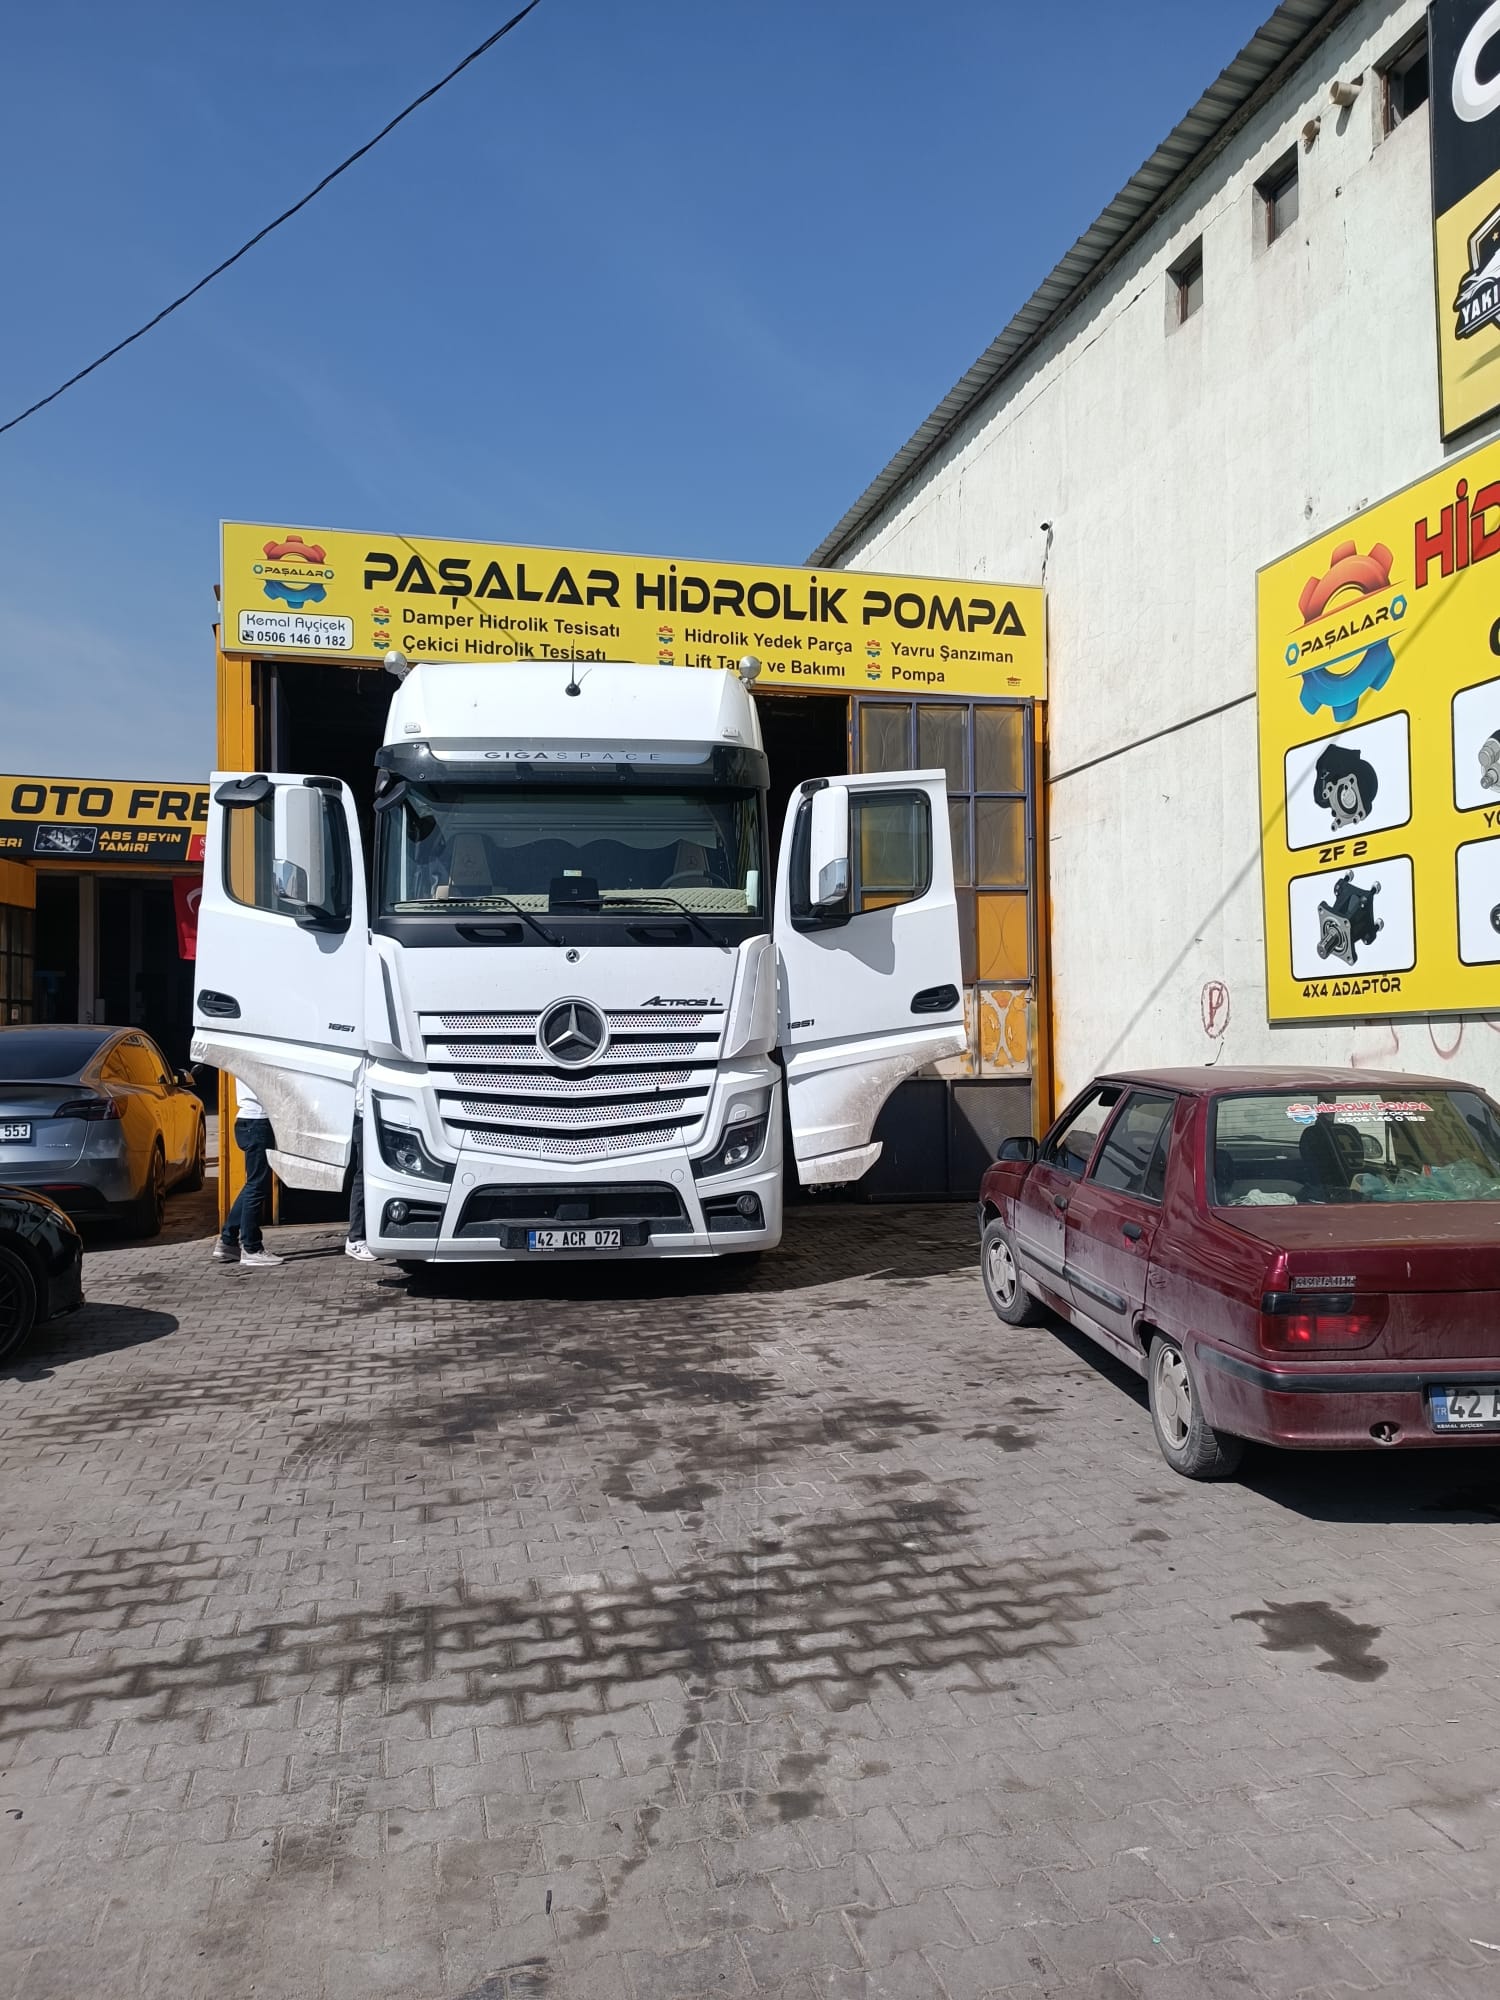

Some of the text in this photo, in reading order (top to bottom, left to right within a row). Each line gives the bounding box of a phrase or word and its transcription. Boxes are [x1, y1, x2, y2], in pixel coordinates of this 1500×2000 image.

[264, 566, 324, 577] PAŞALAR
[364, 551, 1027, 637] PAŞALAR HİDROLİK POMPA
[246, 613, 346, 634] Kemal Ayçiçek
[402, 608, 621, 638] Damper Hidrolik Tesisatı
[1300, 606, 1389, 657] PAŞALAR
[257, 631, 346, 647] 0506 146 0 182
[402, 634, 607, 661] Çekici Hidrolik Tesisatı
[684, 628, 853, 656] Hidrolik Yedek Parça
[891, 641, 1014, 664] Yavru Şanzıman
[685, 653, 712, 669] Lift
[767, 660, 786, 673] ve
[791, 660, 846, 677] Bakımı
[891, 665, 945, 684] Pompa
[484, 751, 663, 761] GIGASPACE
[11, 784, 114, 817] OTO
[98, 842, 149, 853] TAMİRİ
[99, 831, 182, 843] ABS BEYİN
[1318, 841, 1368, 864] ZF 2
[1302, 974, 1401, 998] 4X4 ADAPTÖR
[1375, 1101, 1434, 1112] POMPA
[4, 1124, 28, 1137] 553
[537, 1232, 554, 1247] 42
[562, 1231, 586, 1247] ACR
[594, 1230, 619, 1246] 072
[1435, 1407, 1447, 1417] TR
[1449, 1389, 1483, 1419] 42
